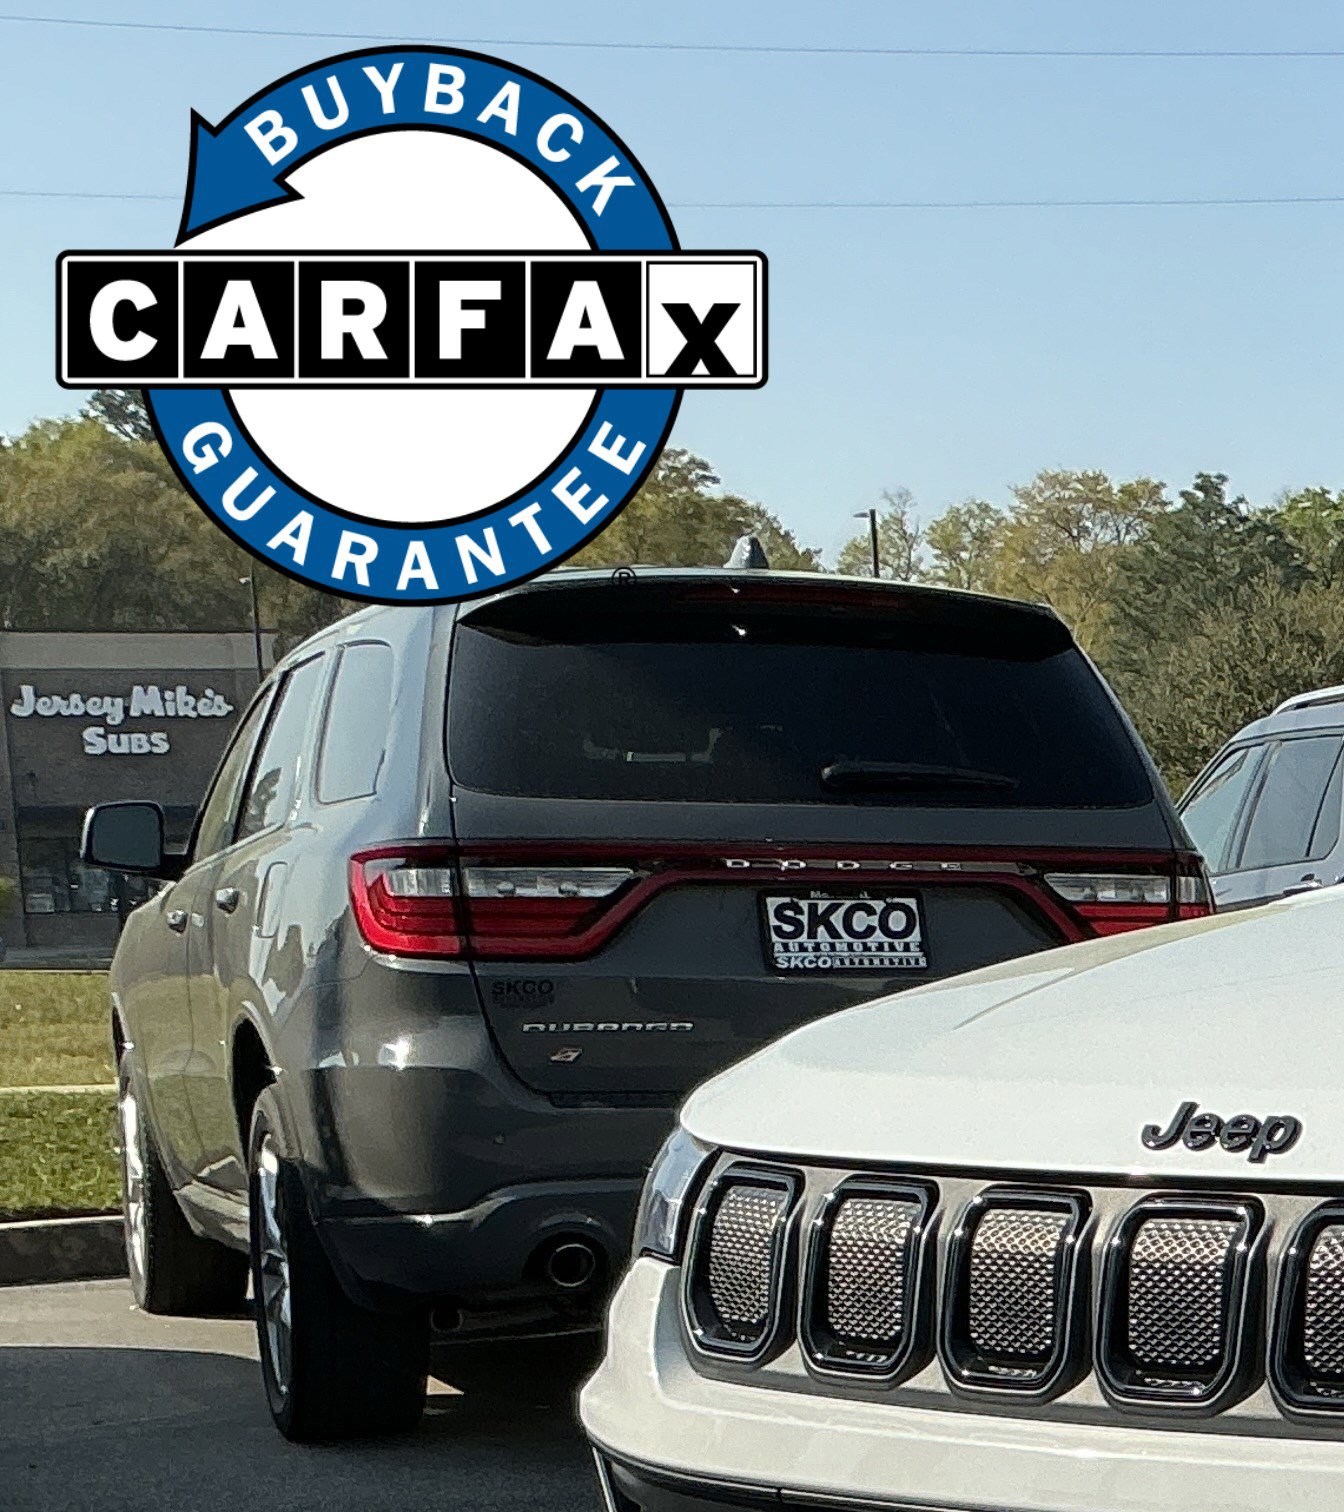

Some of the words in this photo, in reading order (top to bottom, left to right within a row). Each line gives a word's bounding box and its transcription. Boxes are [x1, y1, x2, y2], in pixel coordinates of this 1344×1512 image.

[10, 685, 125, 726] Jersey
[129, 685, 235, 718] Mike's
[772, 901, 918, 940] SKCO
[774, 941, 921, 953] AUTOMOTIVE
[775, 955, 832, 969] SKCO
[491, 979, 555, 995] SKCO
[1141, 1101, 1304, 1164] Jeep
